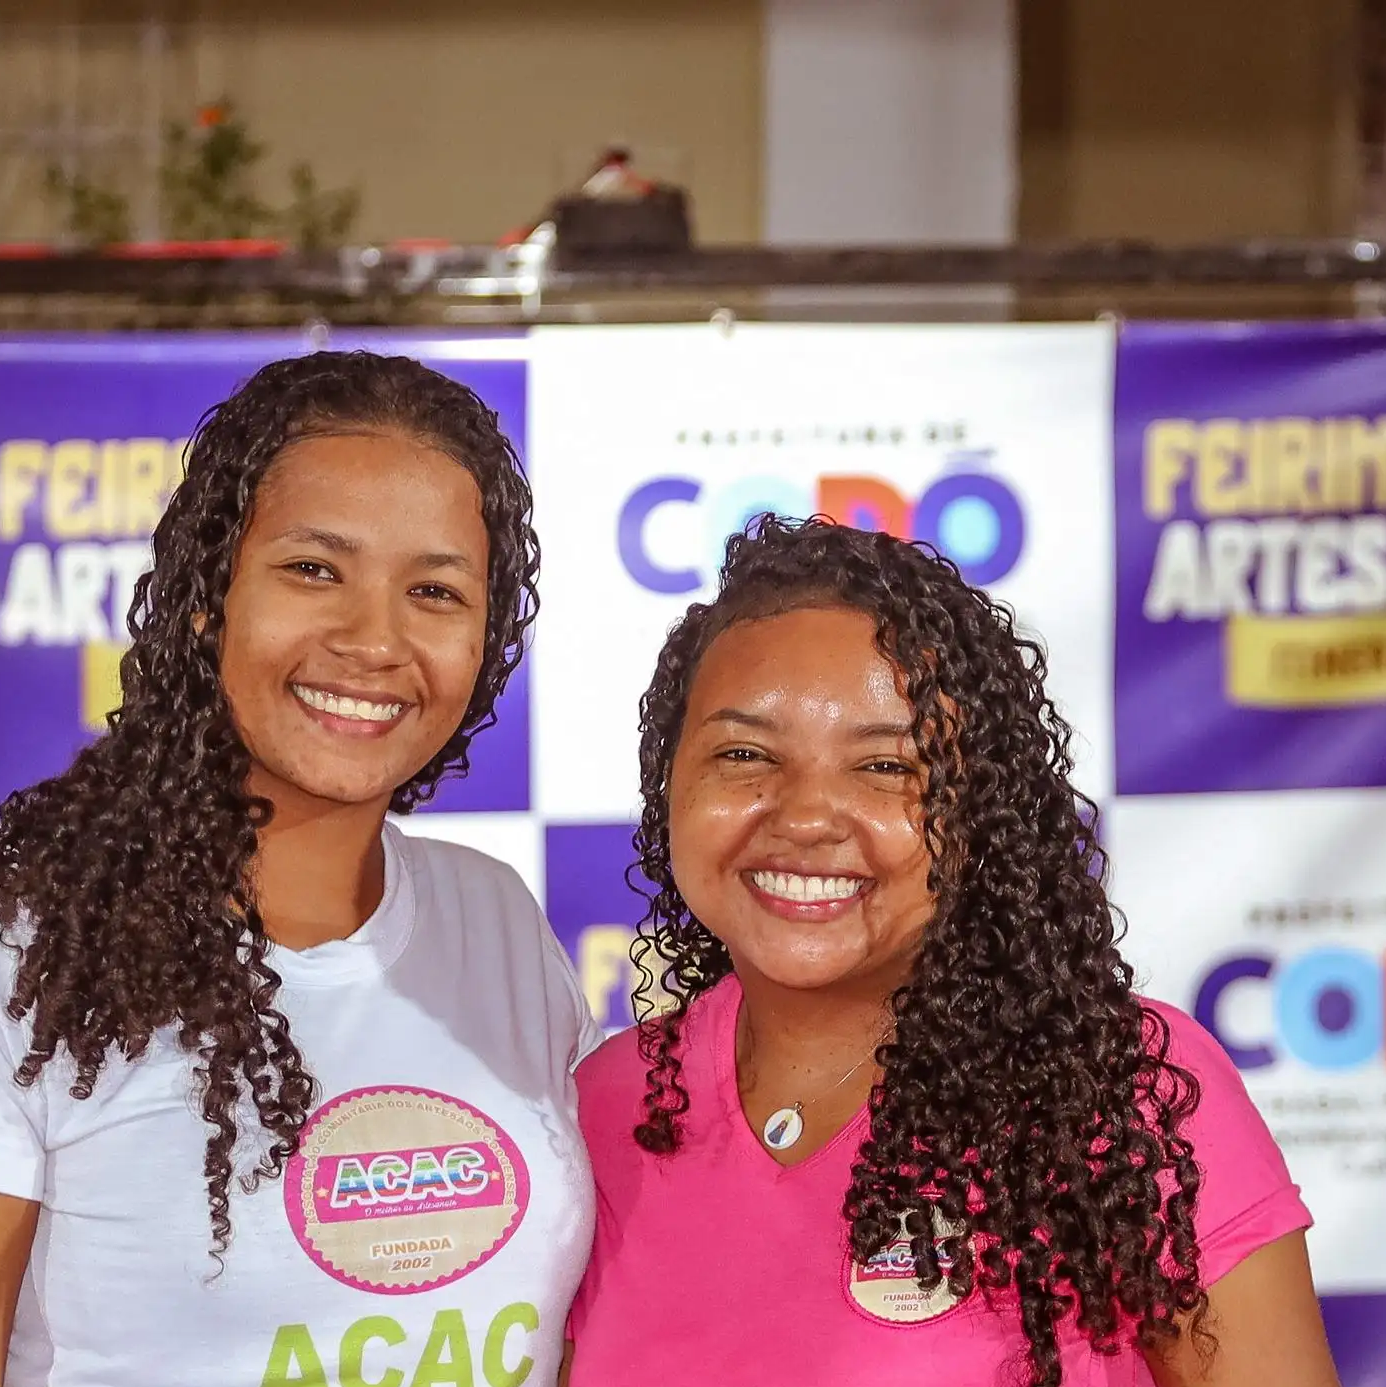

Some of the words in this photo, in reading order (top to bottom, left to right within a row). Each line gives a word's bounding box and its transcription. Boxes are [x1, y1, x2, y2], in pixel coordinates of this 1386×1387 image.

[330, 1147, 489, 1208] ACAC
[372, 1237, 452, 1258] FUNDADA
[391, 1256, 432, 1272] 2002
[883, 1291, 932, 1302] FUNDADA
[894, 1303, 919, 1312] 2002
